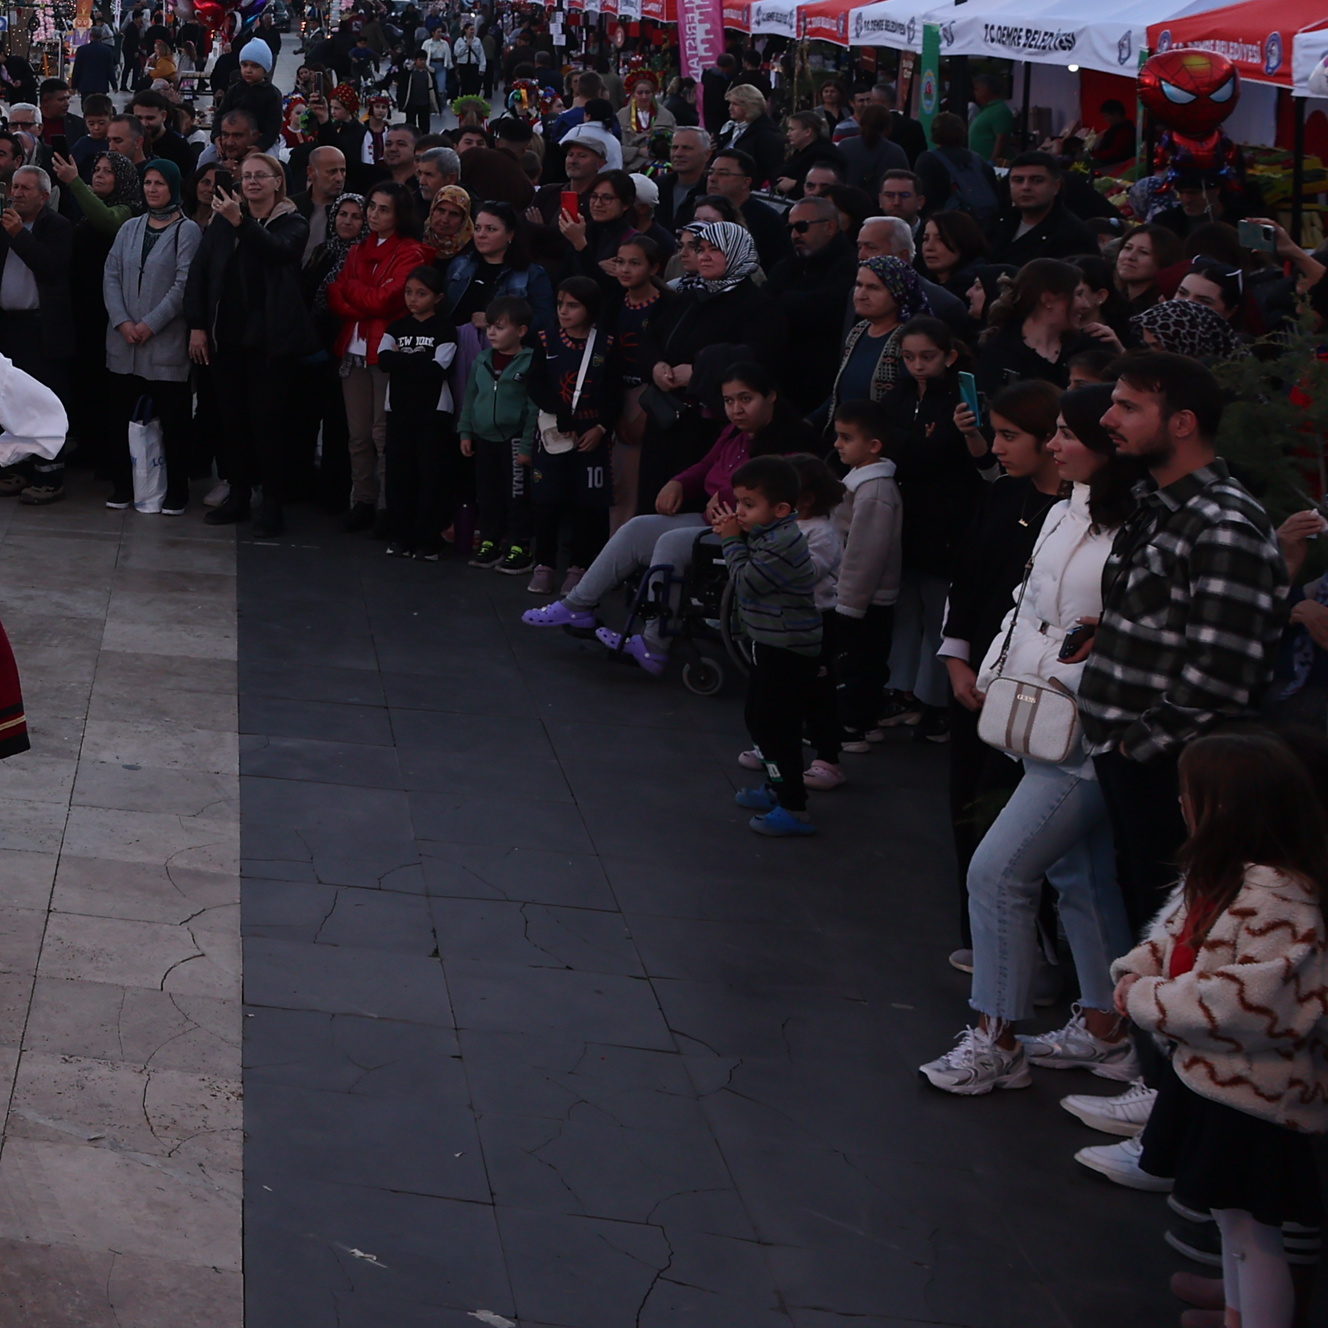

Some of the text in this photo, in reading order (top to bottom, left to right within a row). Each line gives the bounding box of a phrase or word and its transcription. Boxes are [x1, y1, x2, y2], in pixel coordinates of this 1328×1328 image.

[996, 25, 1024, 47] DEMRE
[397, 335, 413, 347] EW
[587, 466, 604, 489] 10
